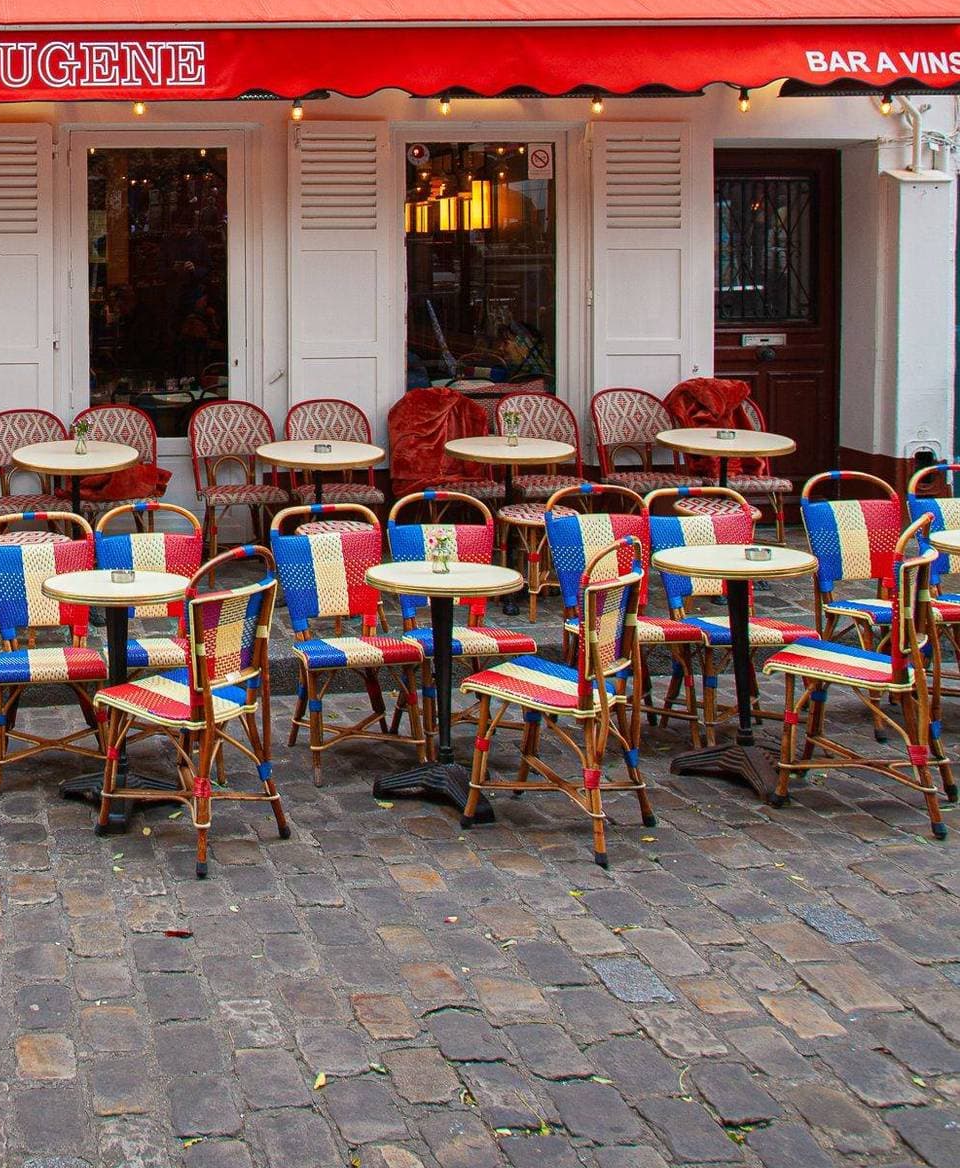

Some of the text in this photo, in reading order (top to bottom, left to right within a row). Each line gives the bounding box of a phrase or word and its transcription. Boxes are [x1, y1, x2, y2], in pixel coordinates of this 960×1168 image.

[805, 51, 960, 74] BAR A VINS
